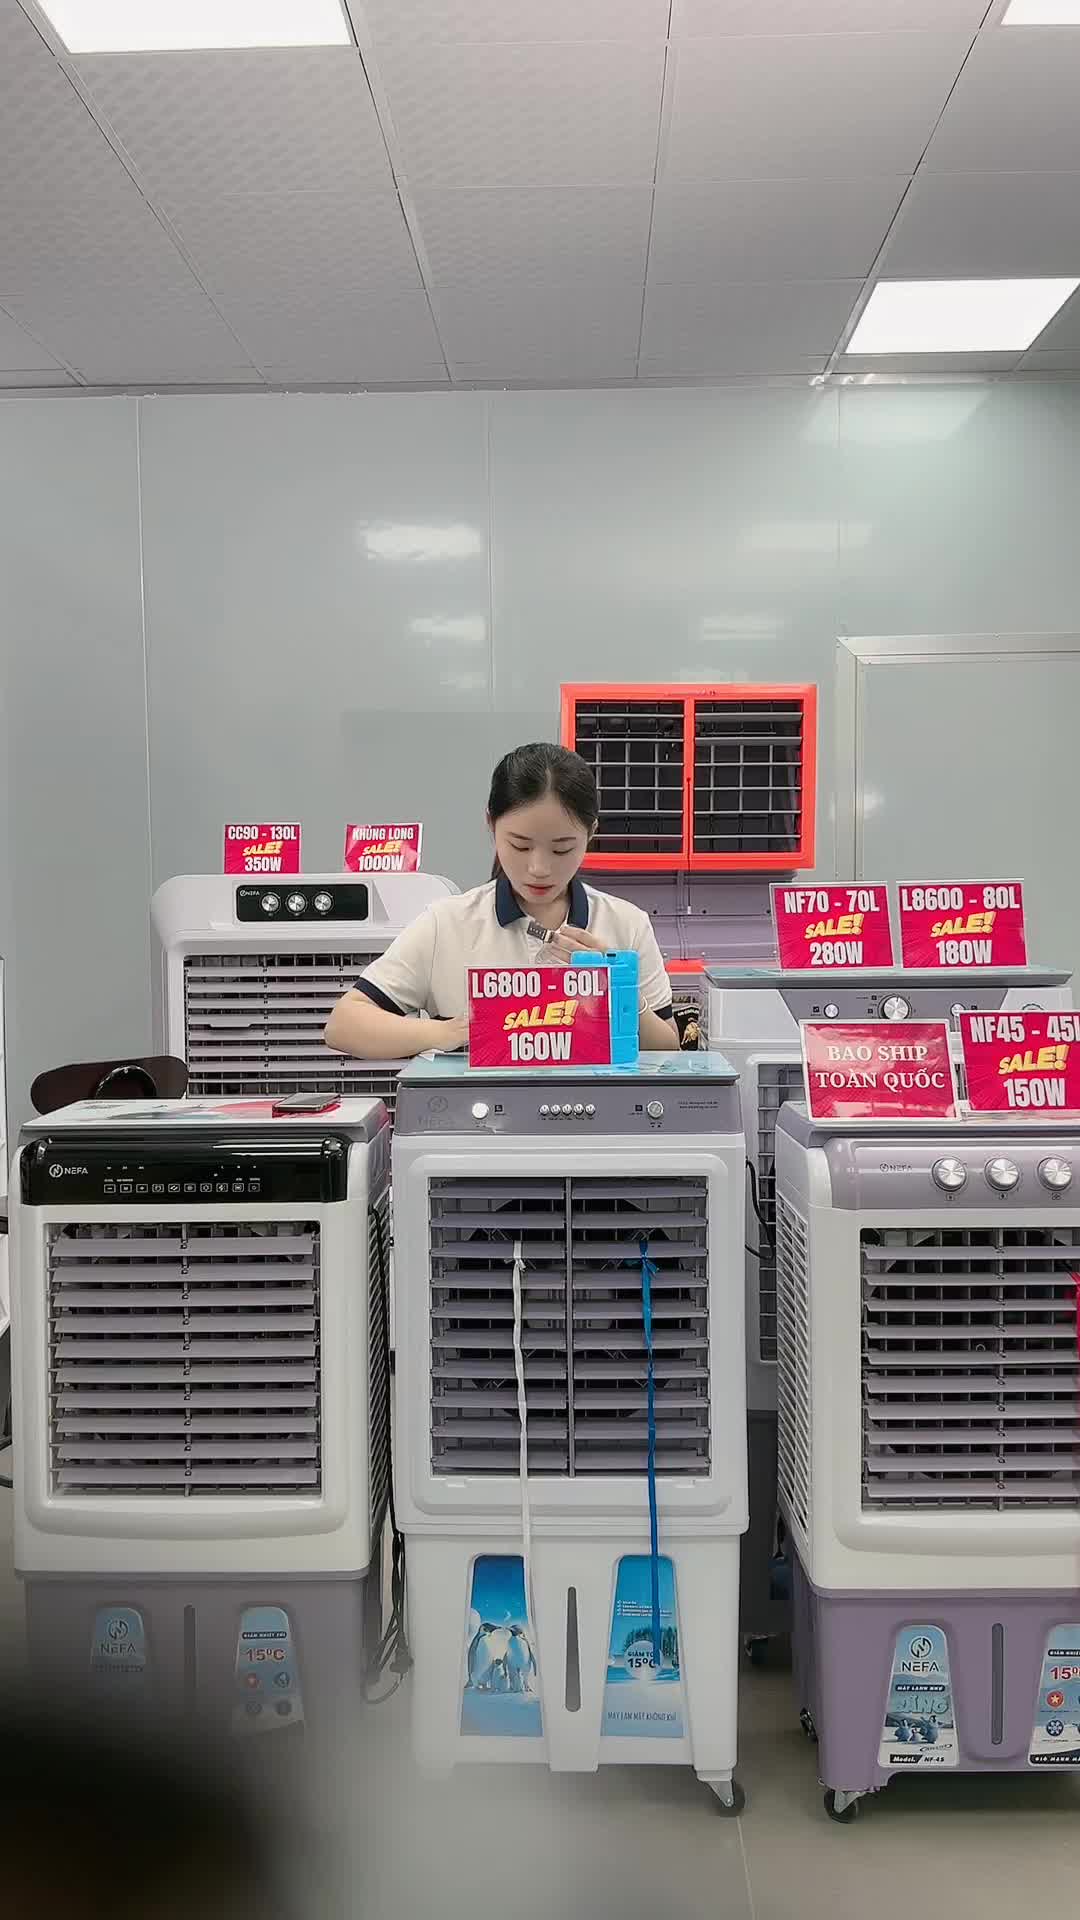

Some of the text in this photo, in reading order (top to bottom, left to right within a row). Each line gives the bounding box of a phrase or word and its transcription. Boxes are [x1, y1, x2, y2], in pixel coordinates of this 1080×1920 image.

[228, 826, 259, 840] CC90
[270, 826, 297, 840] 130L
[388, 826, 414, 841] LONG
[243, 841, 284, 856] SALE!
[244, 857, 282, 872] 350W
[358, 855, 405, 871] 1000W
[784, 891, 829, 914] NF70
[846, 889, 880, 913] 70L
[901, 887, 963, 912] L8600
[982, 886, 1020, 910] 80L
[804, 913, 865, 939] SALE!
[930, 911, 997, 938] SALE!
[809, 941, 863, 965] 280W
[936, 940, 992, 965] 180W
[472, 971, 541, 998] L6800
[563, 970, 604, 997] 60L
[502, 1000, 579, 1031] SALE!
[970, 1016, 1025, 1043] NF45
[508, 1032, 572, 1061] 160W
[827, 1045, 928, 1062] BAO SHIP
[998, 1044, 1070, 1075] SALE!
[815, 1068, 945, 1092] TOÀN QUỐC
[1003, 1078, 1066, 1107] 150W
[64, 1167, 89, 1175] NEFA
[902, 1661, 940, 1672] NEFA
